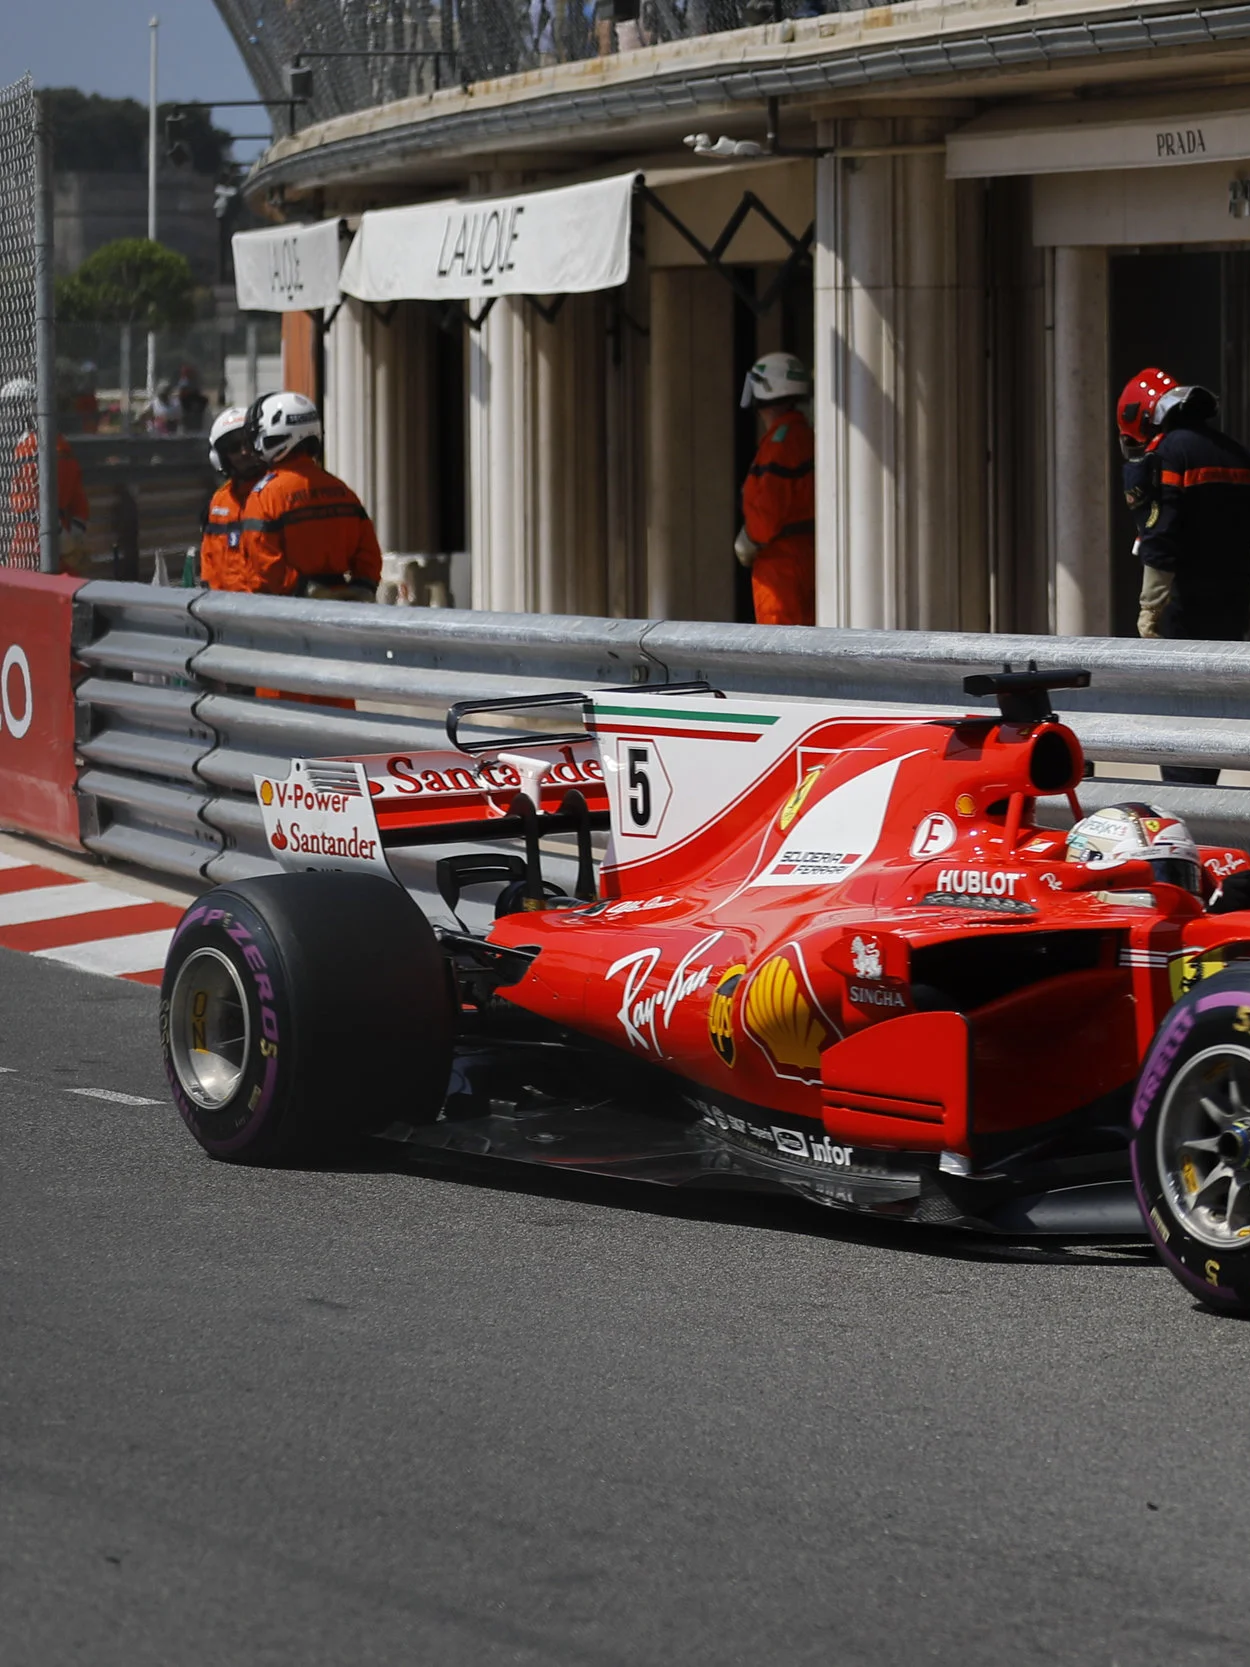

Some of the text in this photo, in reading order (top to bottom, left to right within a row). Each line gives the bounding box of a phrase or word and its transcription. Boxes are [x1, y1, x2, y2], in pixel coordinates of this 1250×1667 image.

[1155, 129, 1207, 157] PRADA
[436, 206, 525, 286] LALIQUE
[0, 644, 33, 739] O
[386, 745, 604, 794] Santade
[627, 746, 651, 829] 5
[275, 783, 349, 813] V-Power
[290, 822, 377, 860] Santander
[917, 818, 945, 854] E
[780, 851, 844, 863] SCUDERIA
[936, 869, 1022, 896] HUBLOT
[203, 907, 280, 1043] P ZERO
[849, 985, 906, 1008] SINGHA
[808, 1134, 854, 1166] infor
